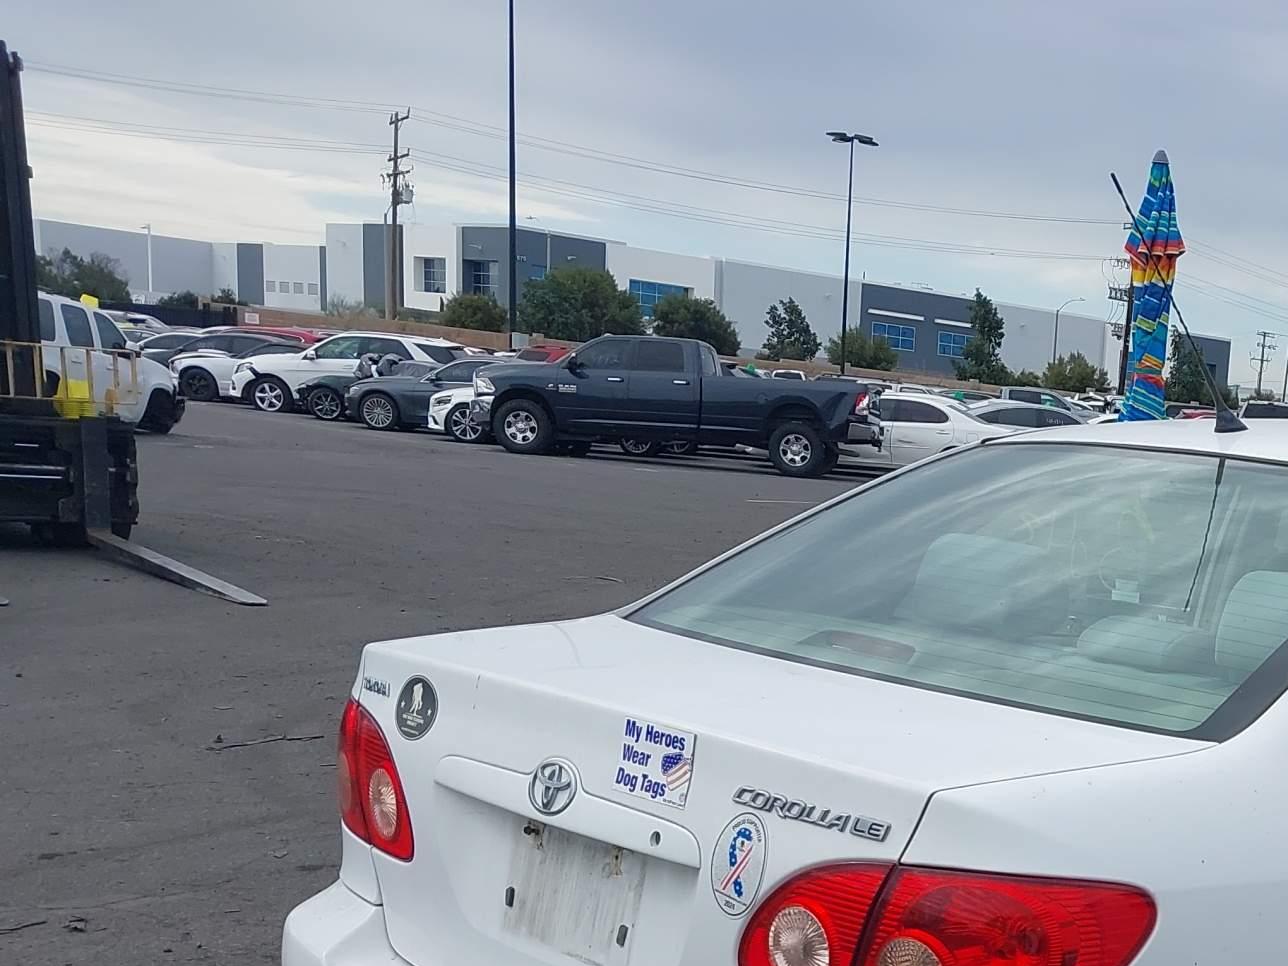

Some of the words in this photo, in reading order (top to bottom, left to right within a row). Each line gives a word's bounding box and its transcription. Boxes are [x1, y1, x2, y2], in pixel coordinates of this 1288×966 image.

[625, 718, 643, 743] My
[645, 724, 686, 752] Heroes
[622, 742, 652, 767] Wear
[615, 766, 639, 793] Dog
[640, 773, 667, 799] Tags
[732, 785, 852, 833] COROLLA
[852, 817, 888, 840] LE
